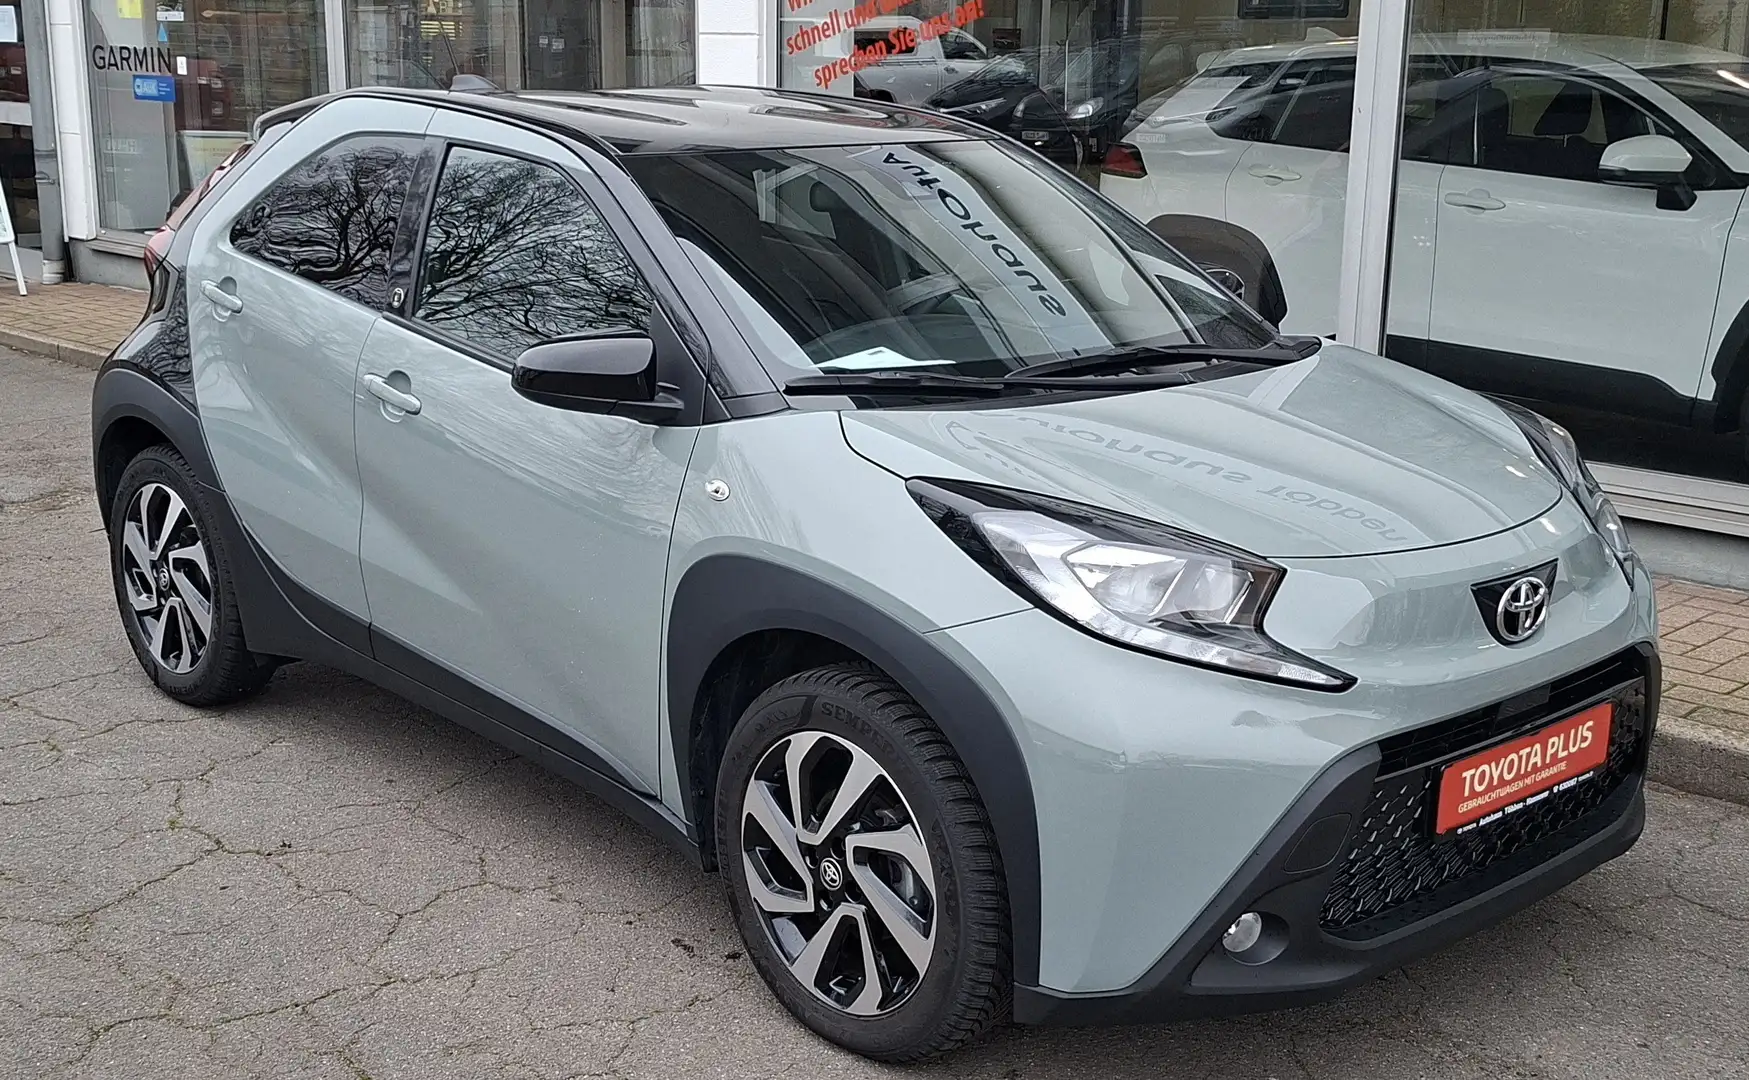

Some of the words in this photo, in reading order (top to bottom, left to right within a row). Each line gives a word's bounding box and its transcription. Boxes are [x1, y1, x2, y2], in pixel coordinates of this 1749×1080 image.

[786, 9, 841, 55] schnell
[814, 39, 889, 90] sprechen
[888, 25, 917, 55] Sie
[920, 11, 952, 41] uns
[93, 44, 172, 74] GARMIN
[1462, 743, 1542, 797] TOYOTA
[1545, 720, 1594, 764] PLUS
[1458, 780, 1524, 813] GEBRAUCHTWAGEN
[1524, 774, 1536, 786] MIT
[1535, 761, 1568, 781] GARANTIE
